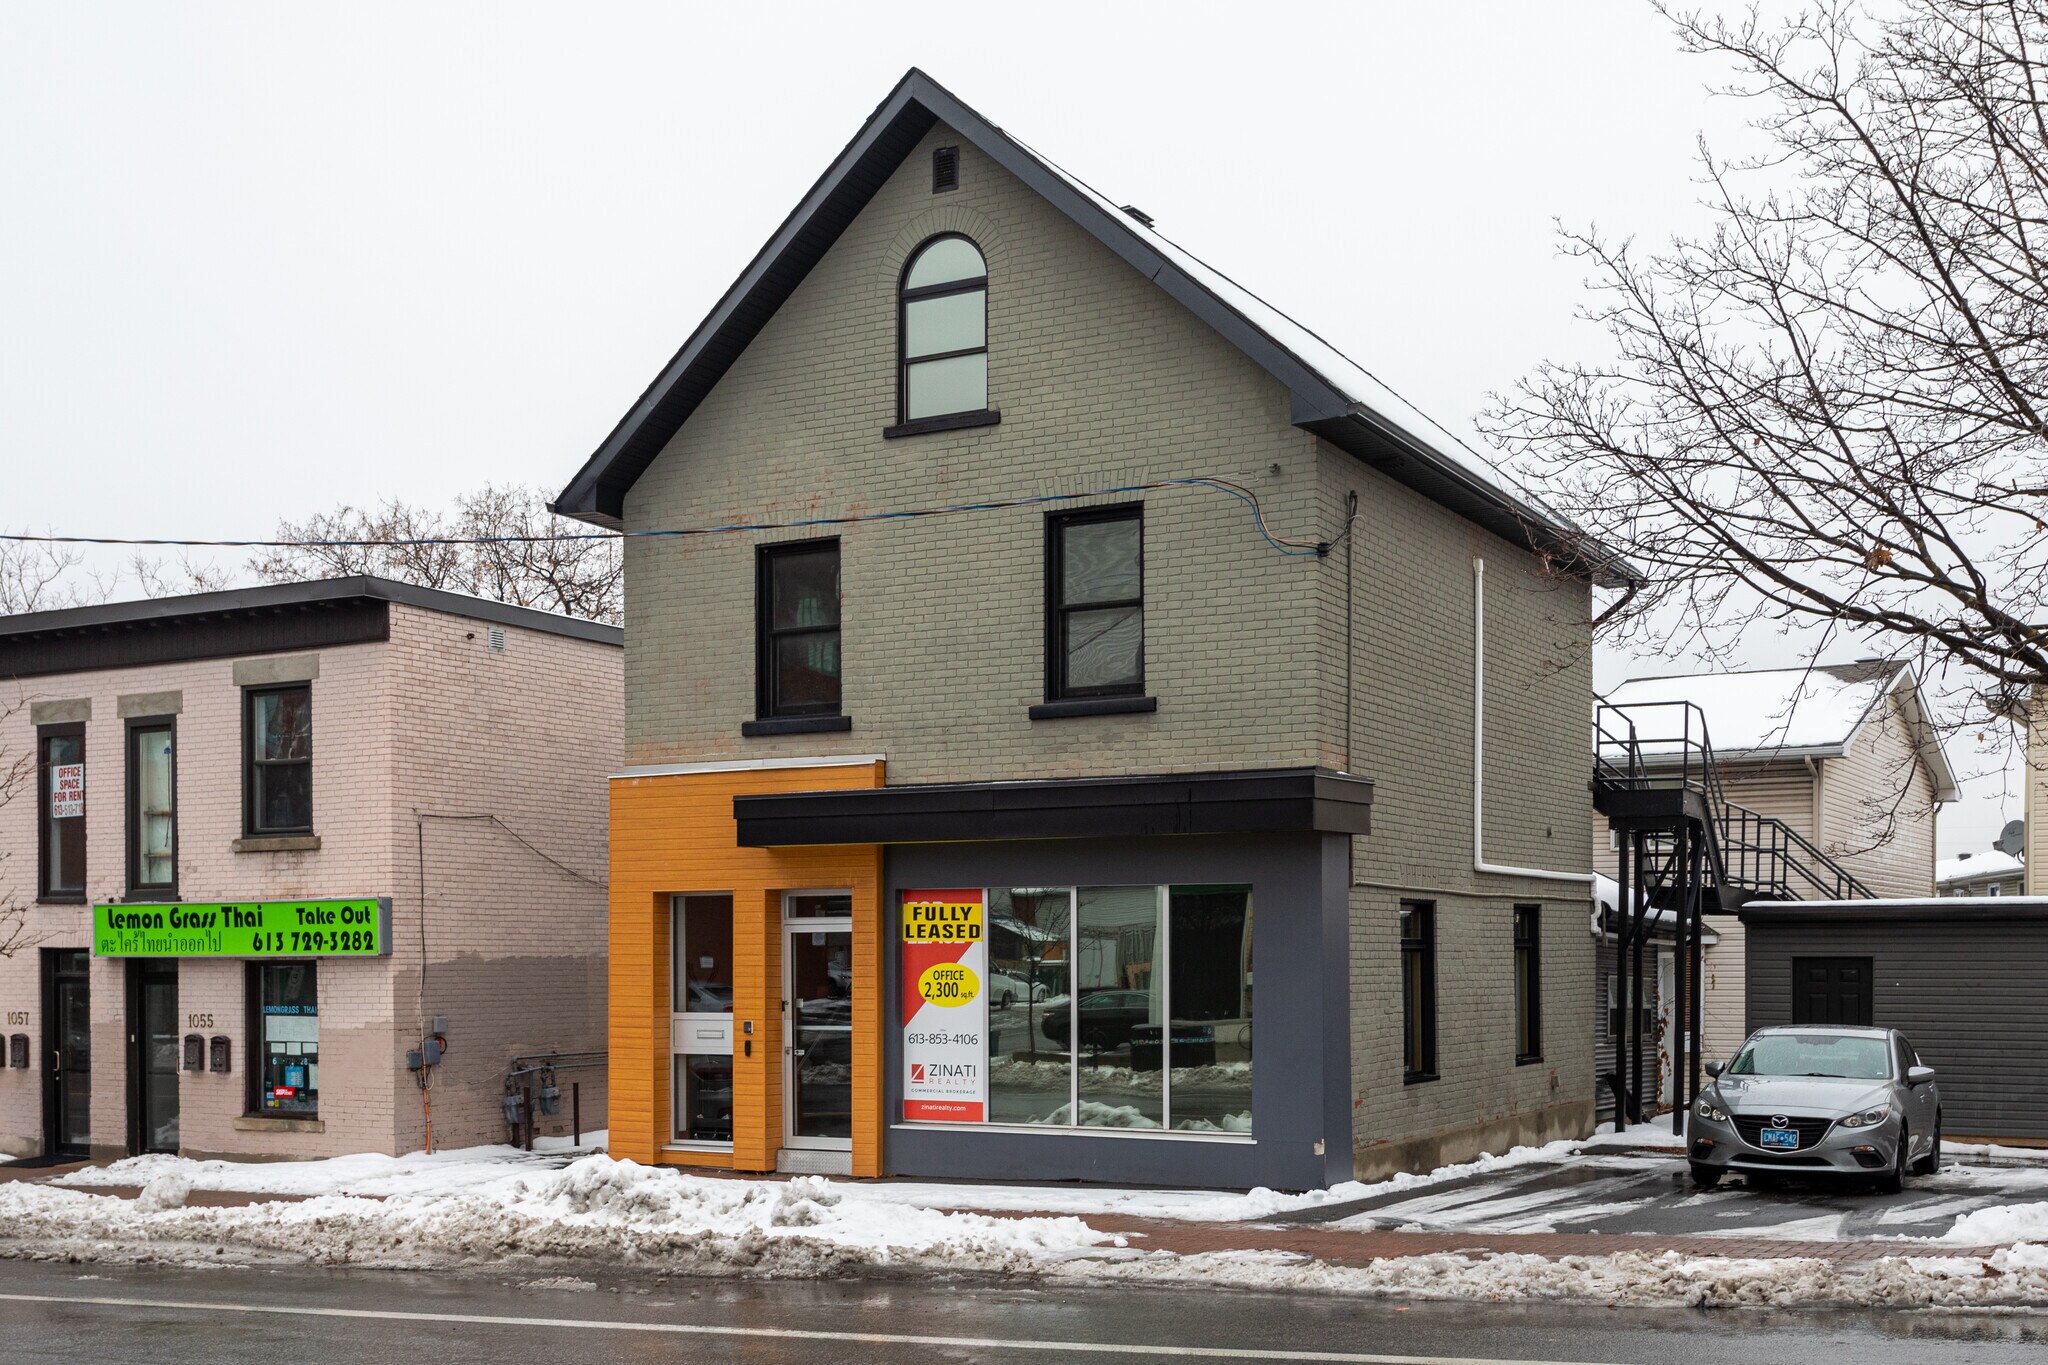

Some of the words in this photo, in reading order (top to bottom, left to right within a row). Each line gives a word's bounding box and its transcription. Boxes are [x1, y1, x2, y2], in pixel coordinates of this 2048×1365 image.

[58, 767, 81, 778] OFFICE
[59, 779, 80, 790] SPACE
[54, 792, 67, 802] FOR
[108, 908, 164, 929] Lemon
[169, 907, 217, 929] Grass
[221, 904, 263, 928] Thai
[296, 907, 336, 926] Take
[340, 906, 371, 925] Out
[912, 906, 973, 921] FULLY
[905, 923, 981, 939] LEASED
[252, 931, 284, 952] 613
[291, 930, 374, 952] 729-3282
[933, 970, 964, 980] OFFICE
[924, 981, 959, 1000] 2,300
[263, 1005, 300, 1014] LEMONGRASS
[7, 1011, 29, 1026] 1057
[188, 1013, 214, 1028] 1055
[908, 1033, 979, 1045] 613-853-4106
[929, 1064, 976, 1077] ZINATI
[920, 1104, 967, 1112] zinatirealty.com
